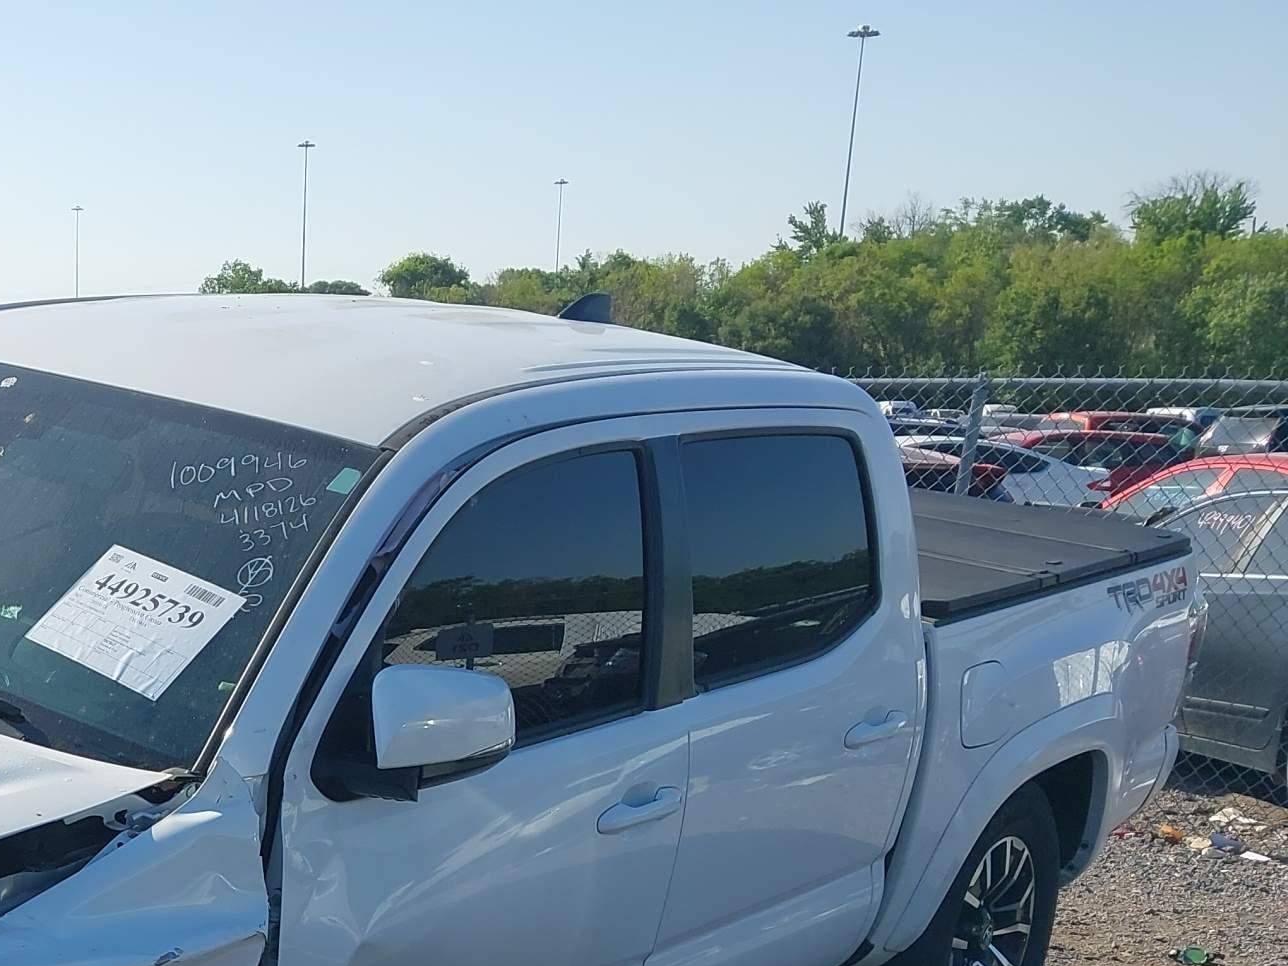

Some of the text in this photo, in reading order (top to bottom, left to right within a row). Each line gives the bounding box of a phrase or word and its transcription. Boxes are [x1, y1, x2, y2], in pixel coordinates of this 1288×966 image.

[170, 451, 307, 489] 1009946
[213, 477, 294, 508] MPD
[239, 513, 310, 552] 3374
[95, 573, 205, 629] 44925739
[1156, 588, 1187, 608] SPORT
